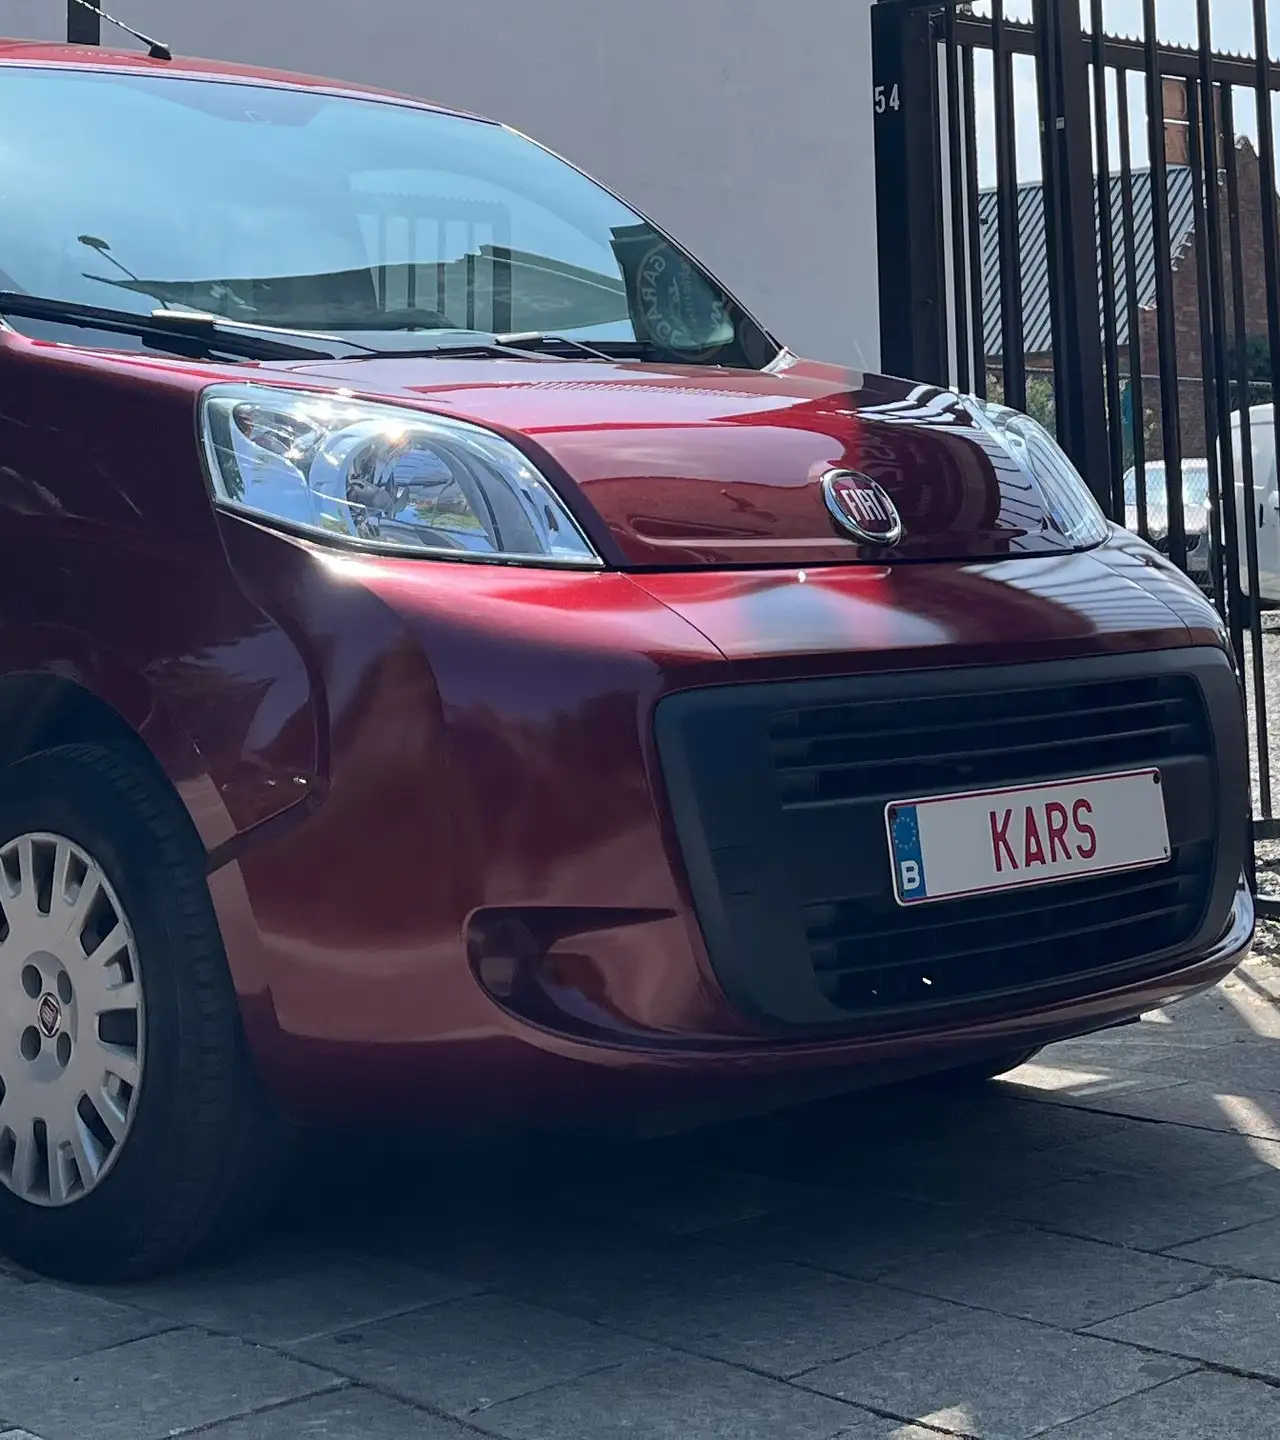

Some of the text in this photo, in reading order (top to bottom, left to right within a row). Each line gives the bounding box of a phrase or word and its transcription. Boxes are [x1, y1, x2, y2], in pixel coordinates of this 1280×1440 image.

[874, 83, 900, 114] 54
[840, 489, 888, 522] FIAT
[900, 798, 1097, 891] B KARS
